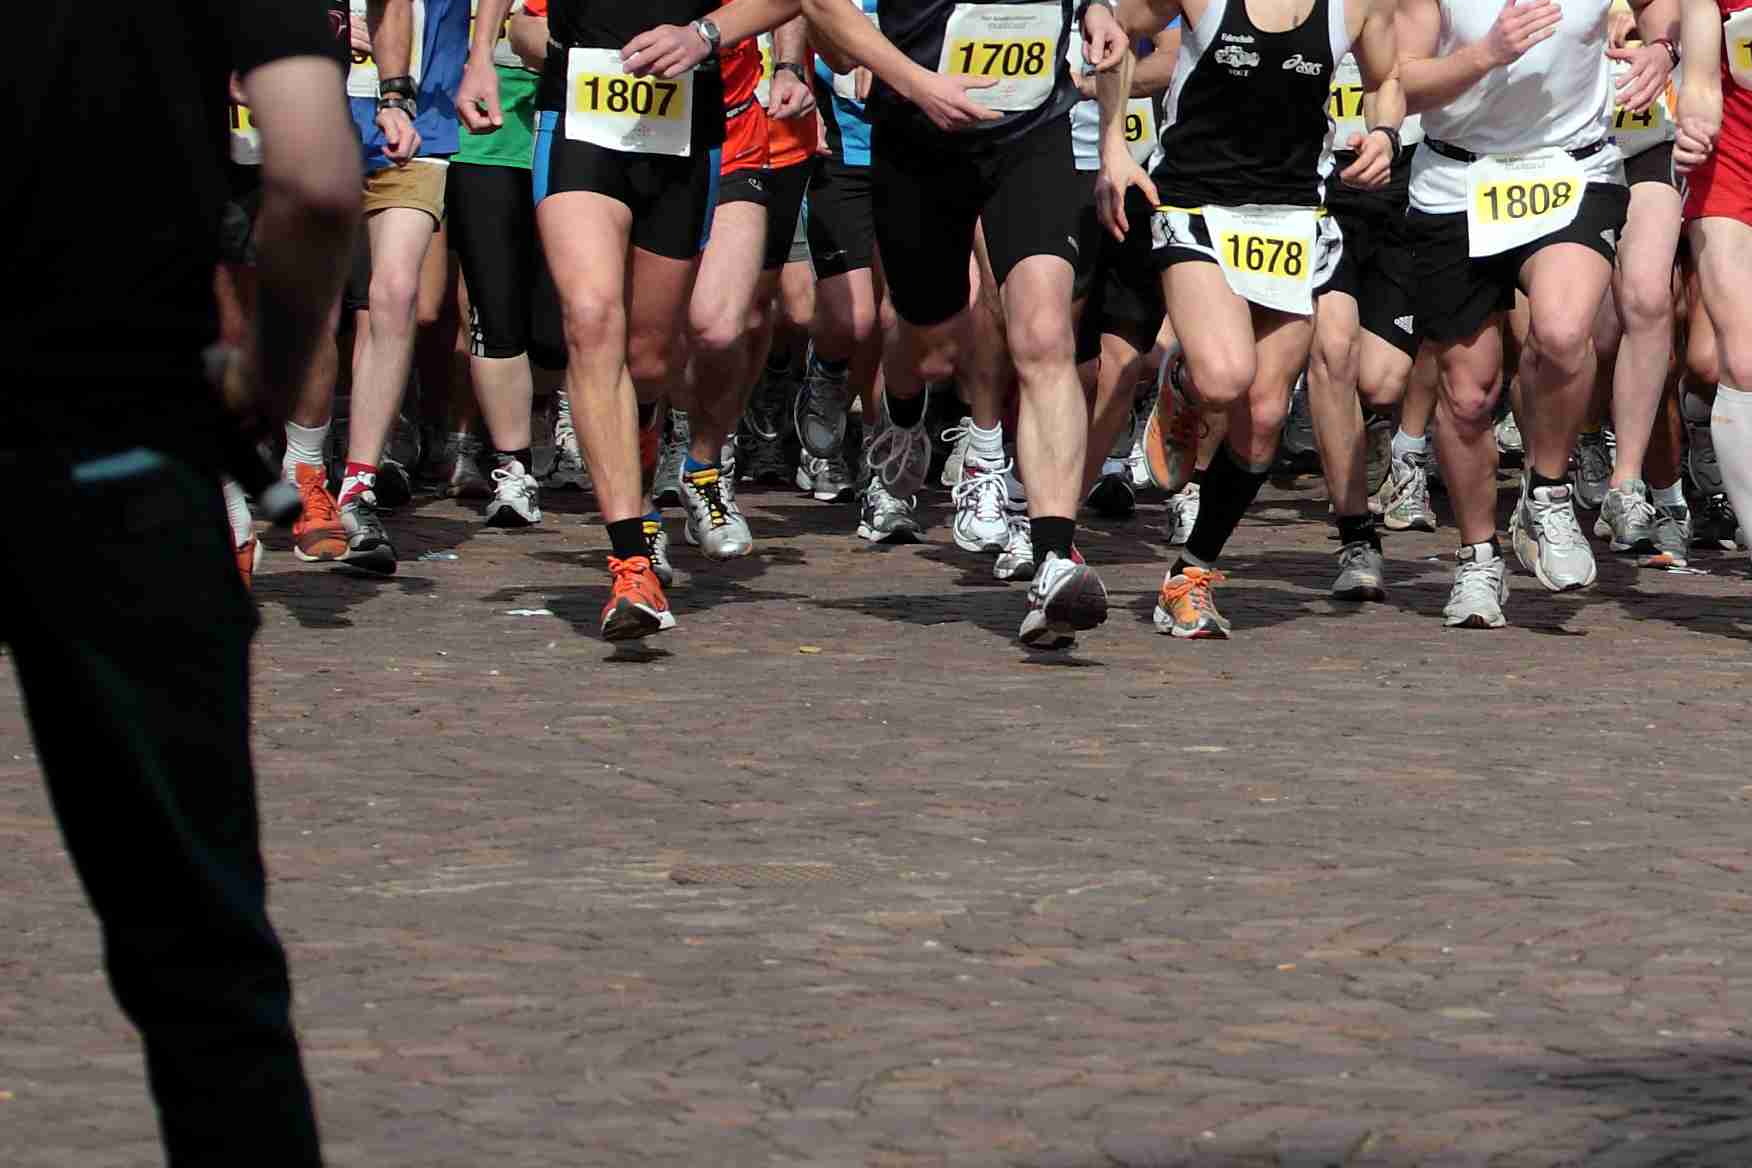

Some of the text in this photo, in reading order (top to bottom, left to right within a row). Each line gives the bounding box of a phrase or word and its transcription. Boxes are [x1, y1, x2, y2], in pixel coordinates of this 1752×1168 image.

[959, 42, 1046, 76] 1708
[584, 76, 678, 117] 1807
[1482, 181, 1572, 221] 1808
[1227, 234, 1303, 276] 1678
